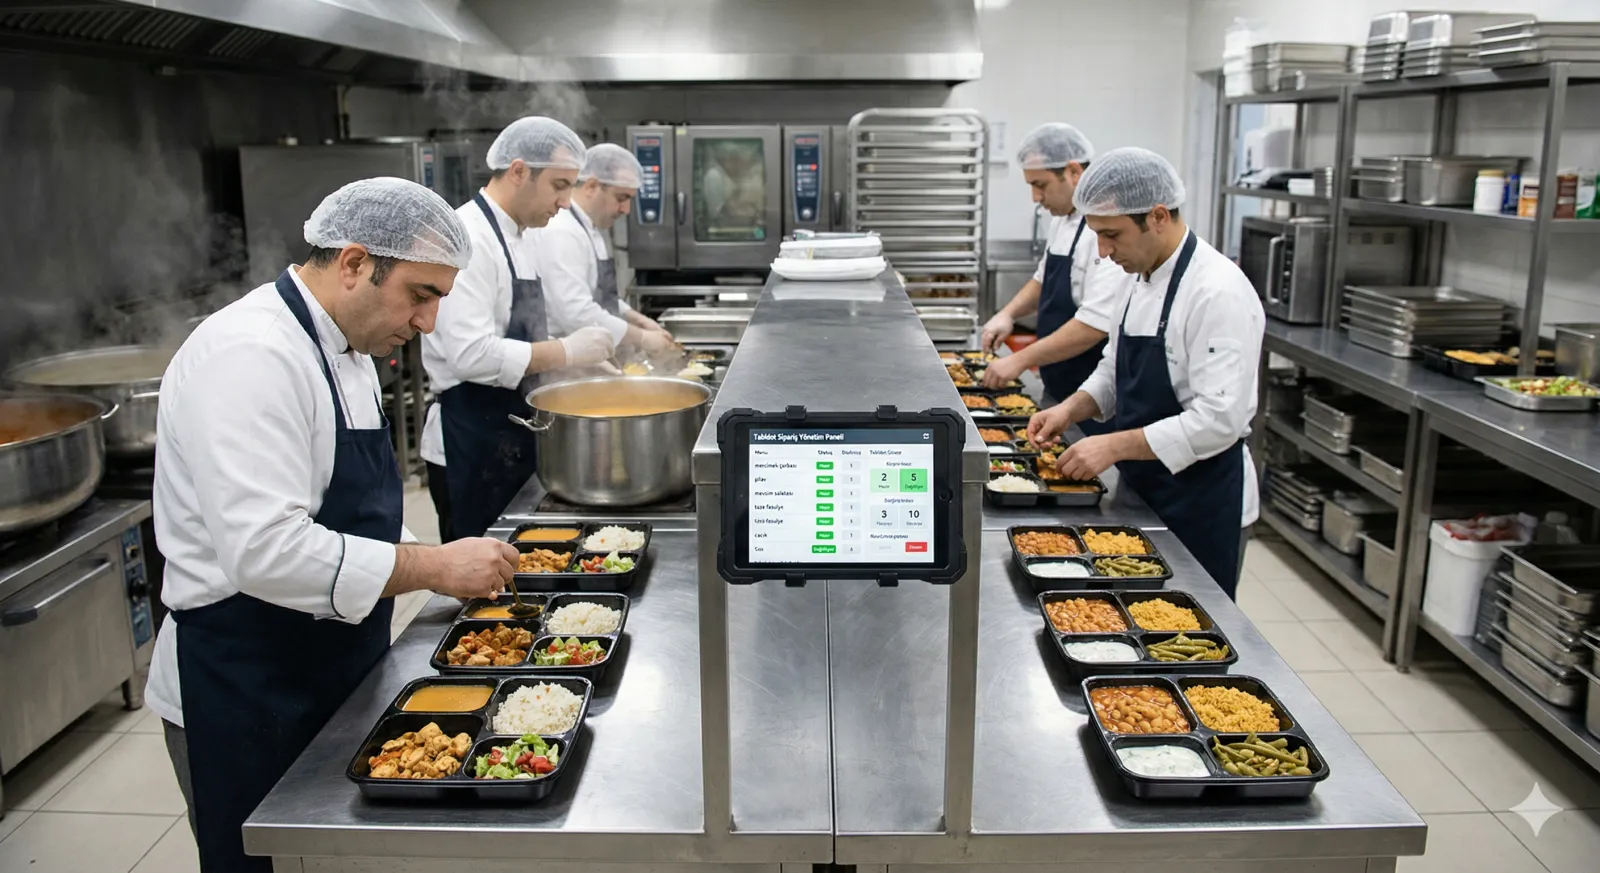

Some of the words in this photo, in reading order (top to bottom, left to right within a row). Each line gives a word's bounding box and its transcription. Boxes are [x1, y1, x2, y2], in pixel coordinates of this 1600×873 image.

[778, 433, 798, 442] Sipariş
[881, 473, 887, 481] 2
[911, 473, 917, 481] 5
[881, 510, 887, 518] 3
[908, 510, 920, 518] 10
